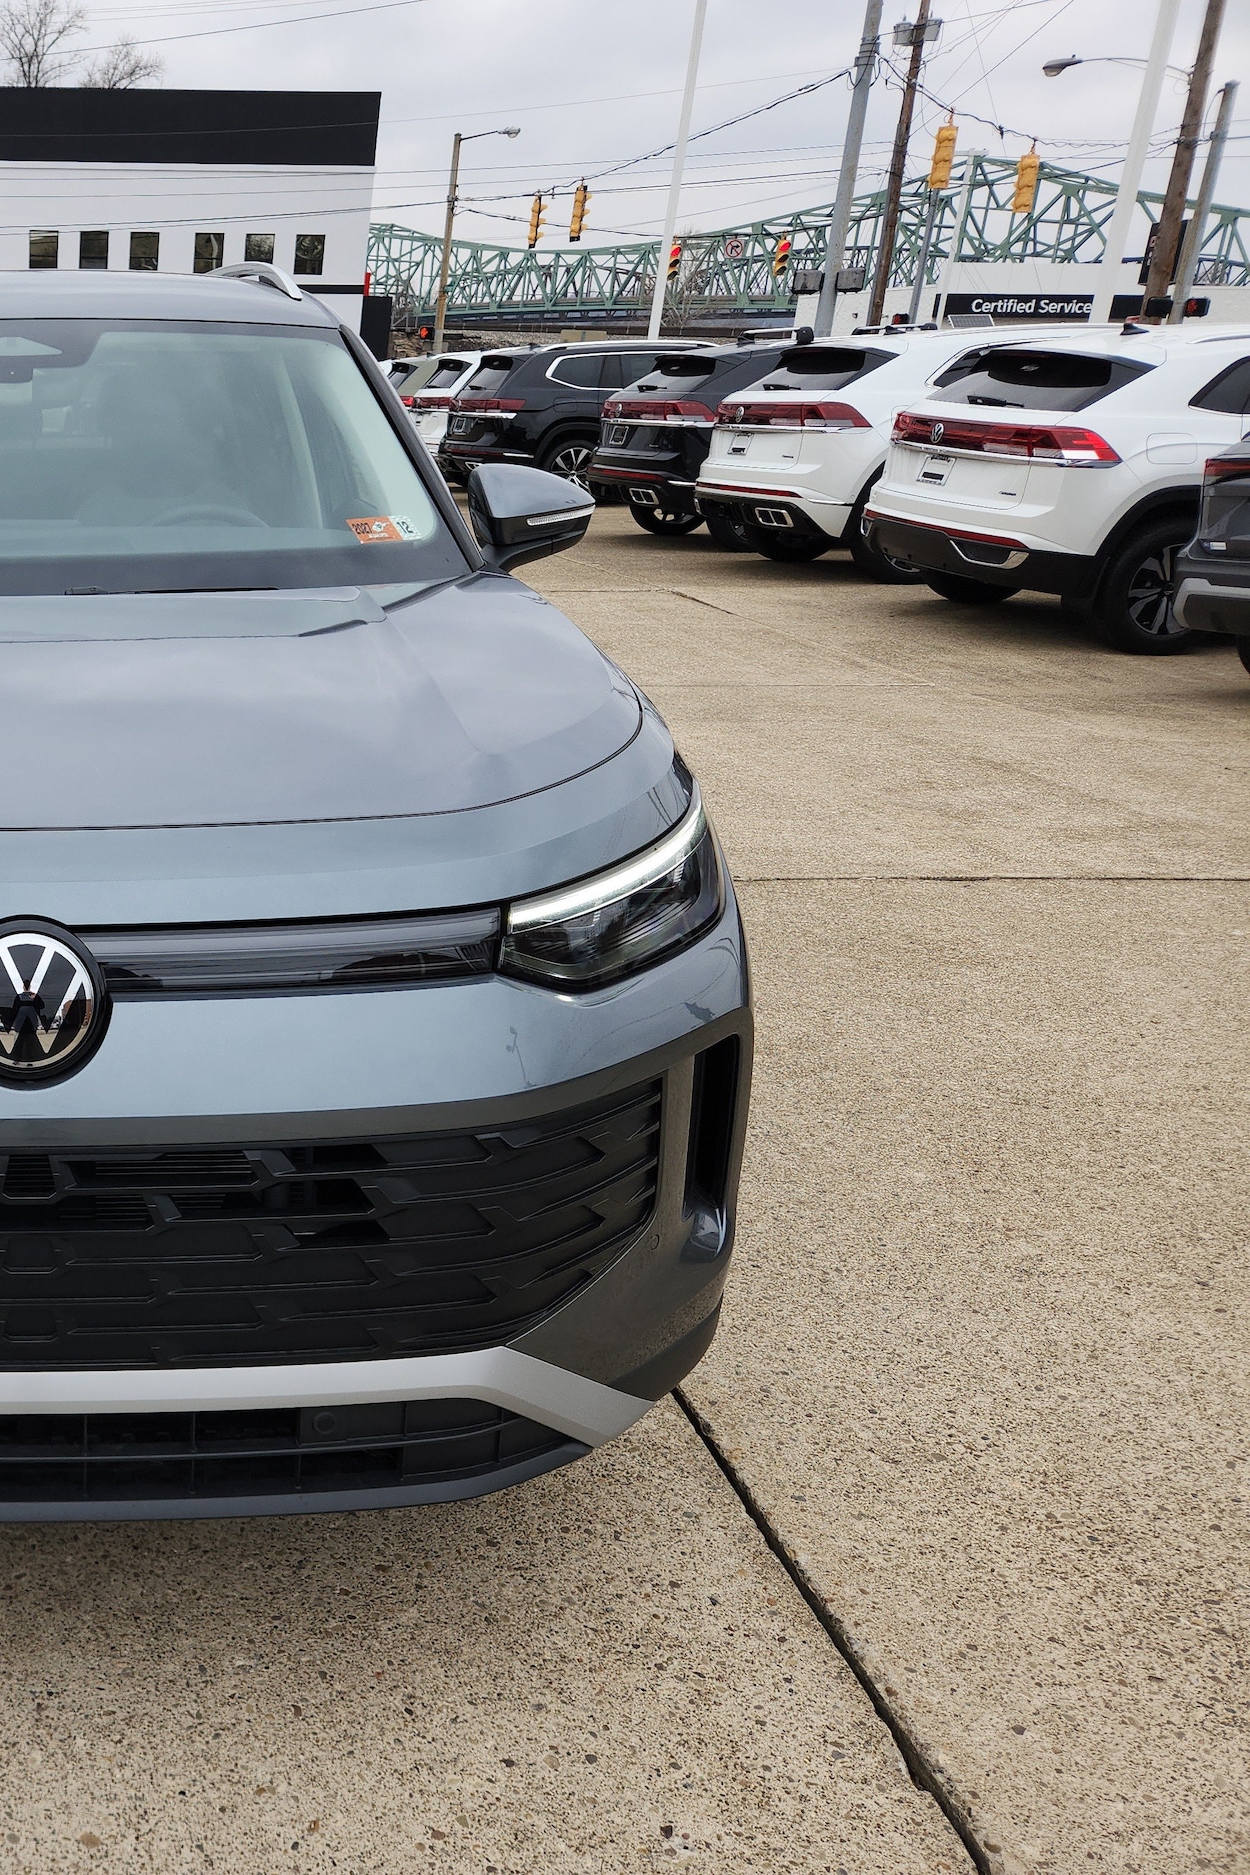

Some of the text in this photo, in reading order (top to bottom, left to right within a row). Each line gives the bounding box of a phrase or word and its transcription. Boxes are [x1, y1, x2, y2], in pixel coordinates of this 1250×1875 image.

[971, 299, 1092, 314] Certified Service
[351, 522, 372, 535] 2027
[396, 520, 414, 534] 12
